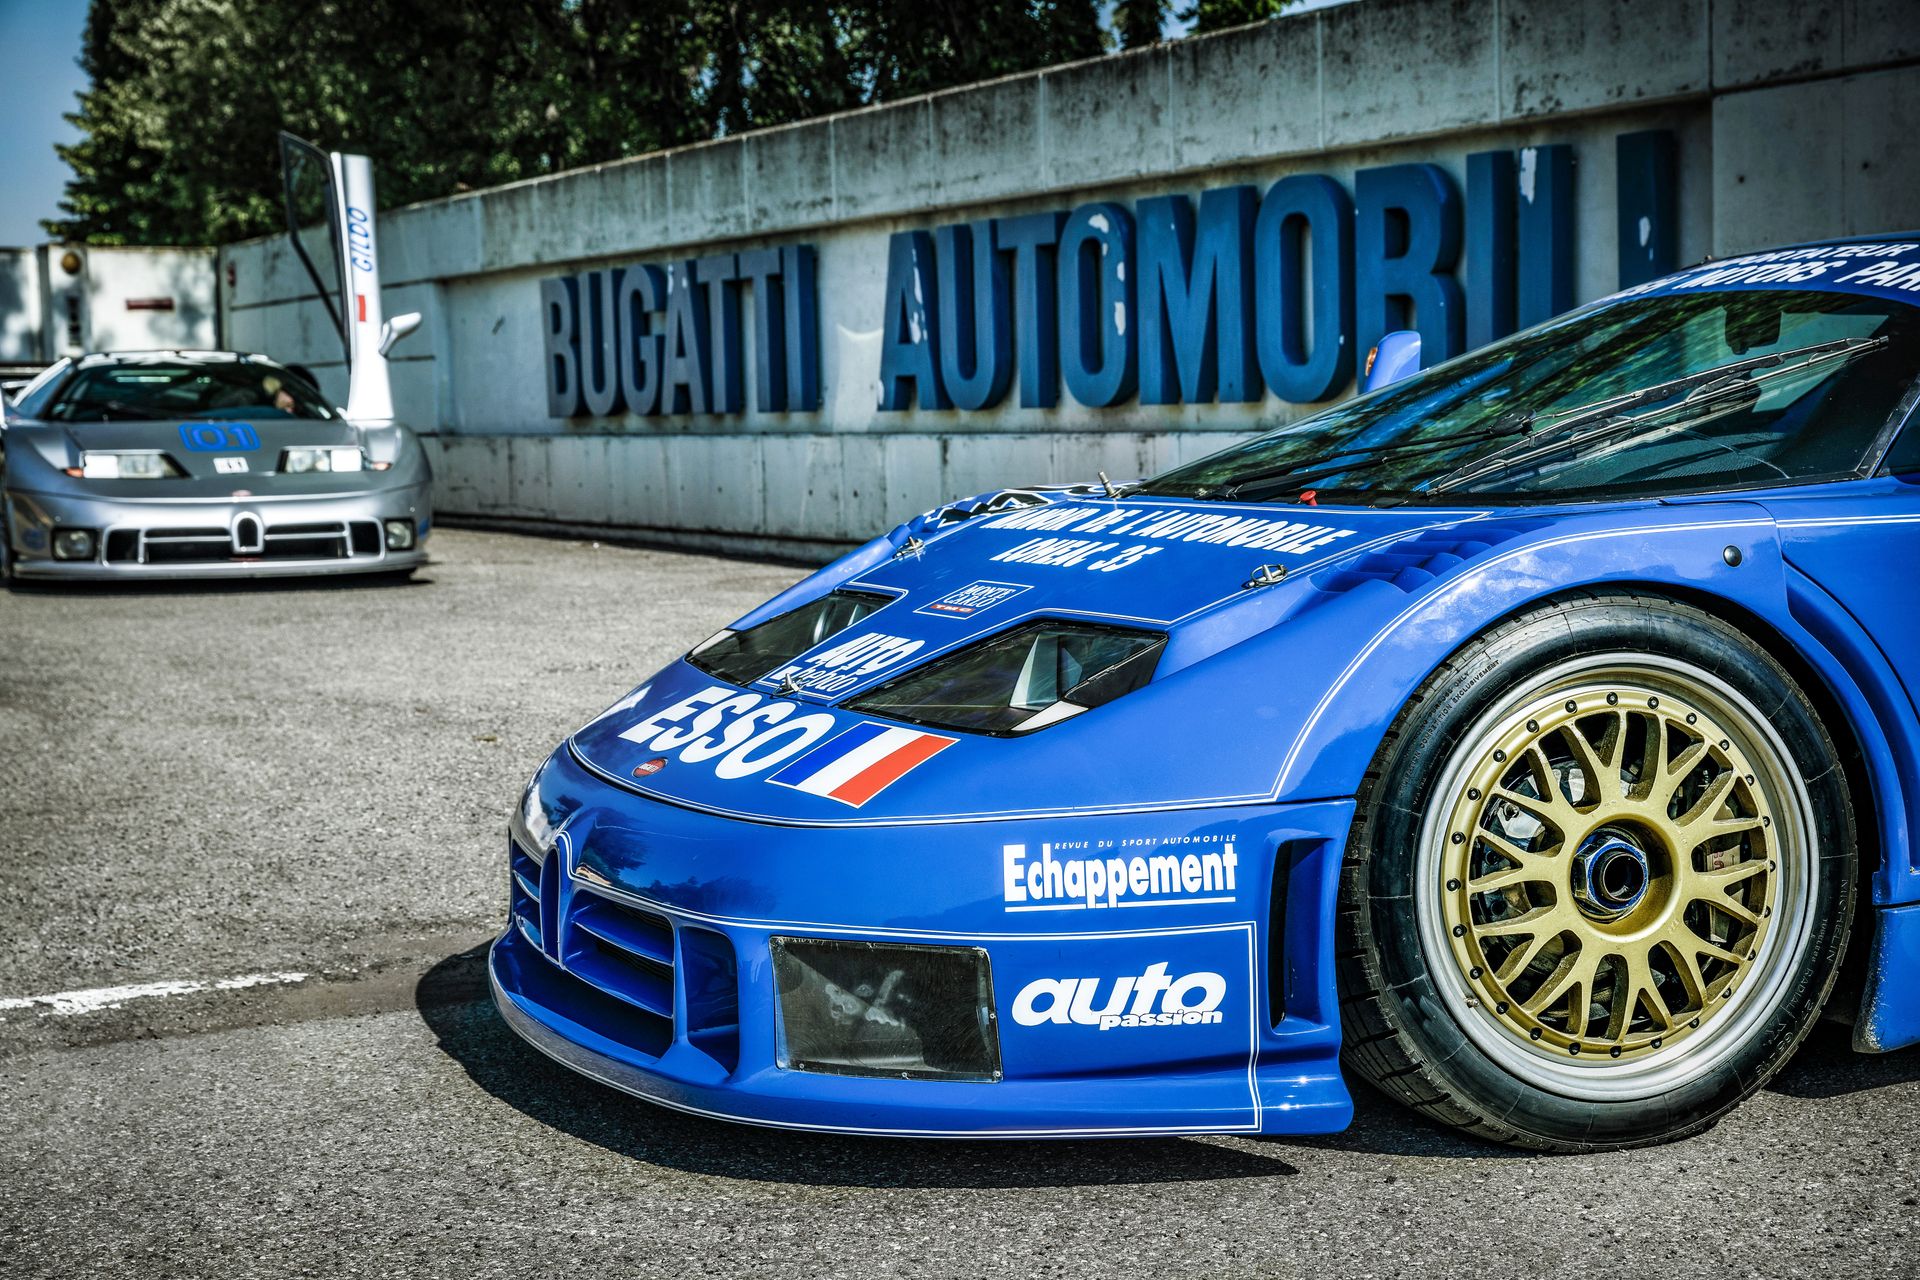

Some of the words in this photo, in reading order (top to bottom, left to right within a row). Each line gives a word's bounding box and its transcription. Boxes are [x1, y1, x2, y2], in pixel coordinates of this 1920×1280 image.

[347, 206, 373, 272] GILDO
[1671, 260, 1847, 290] MOTORS
[541, 244, 818, 419] BUGATTI
[979, 508, 1100, 531] MANOIR
[1069, 509, 1143, 533] DE
[1108, 510, 1358, 555] L'AUTOMOBILE
[988, 537, 1120, 568] LOHEAC
[1087, 545, 1164, 572] 35
[943, 593, 997, 608] CARLO
[960, 584, 1017, 599] MONTE
[804, 632, 926, 676] AUTO
[799, 667, 858, 692] hebdo
[1453, 670, 1470, 687] ONLY
[1420, 704, 1452, 749] COMPETITION
[1452, 659, 1500, 703] EXCLUSIVEMENT
[617, 686, 836, 780] ESSO
[1055, 841, 1088, 849] REVUE
[1098, 840, 1113, 848] DU
[1122, 838, 1157, 847] SPORT
[1163, 834, 1237, 845] AUTOMOBILE
[1003, 843, 1237, 908] Echappement
[1826, 879, 1848, 963] MICHELIN
[1011, 961, 1227, 1026] auto
[1787, 967, 1813, 1011] RADIAL
[1099, 1008, 1223, 1031] passion
